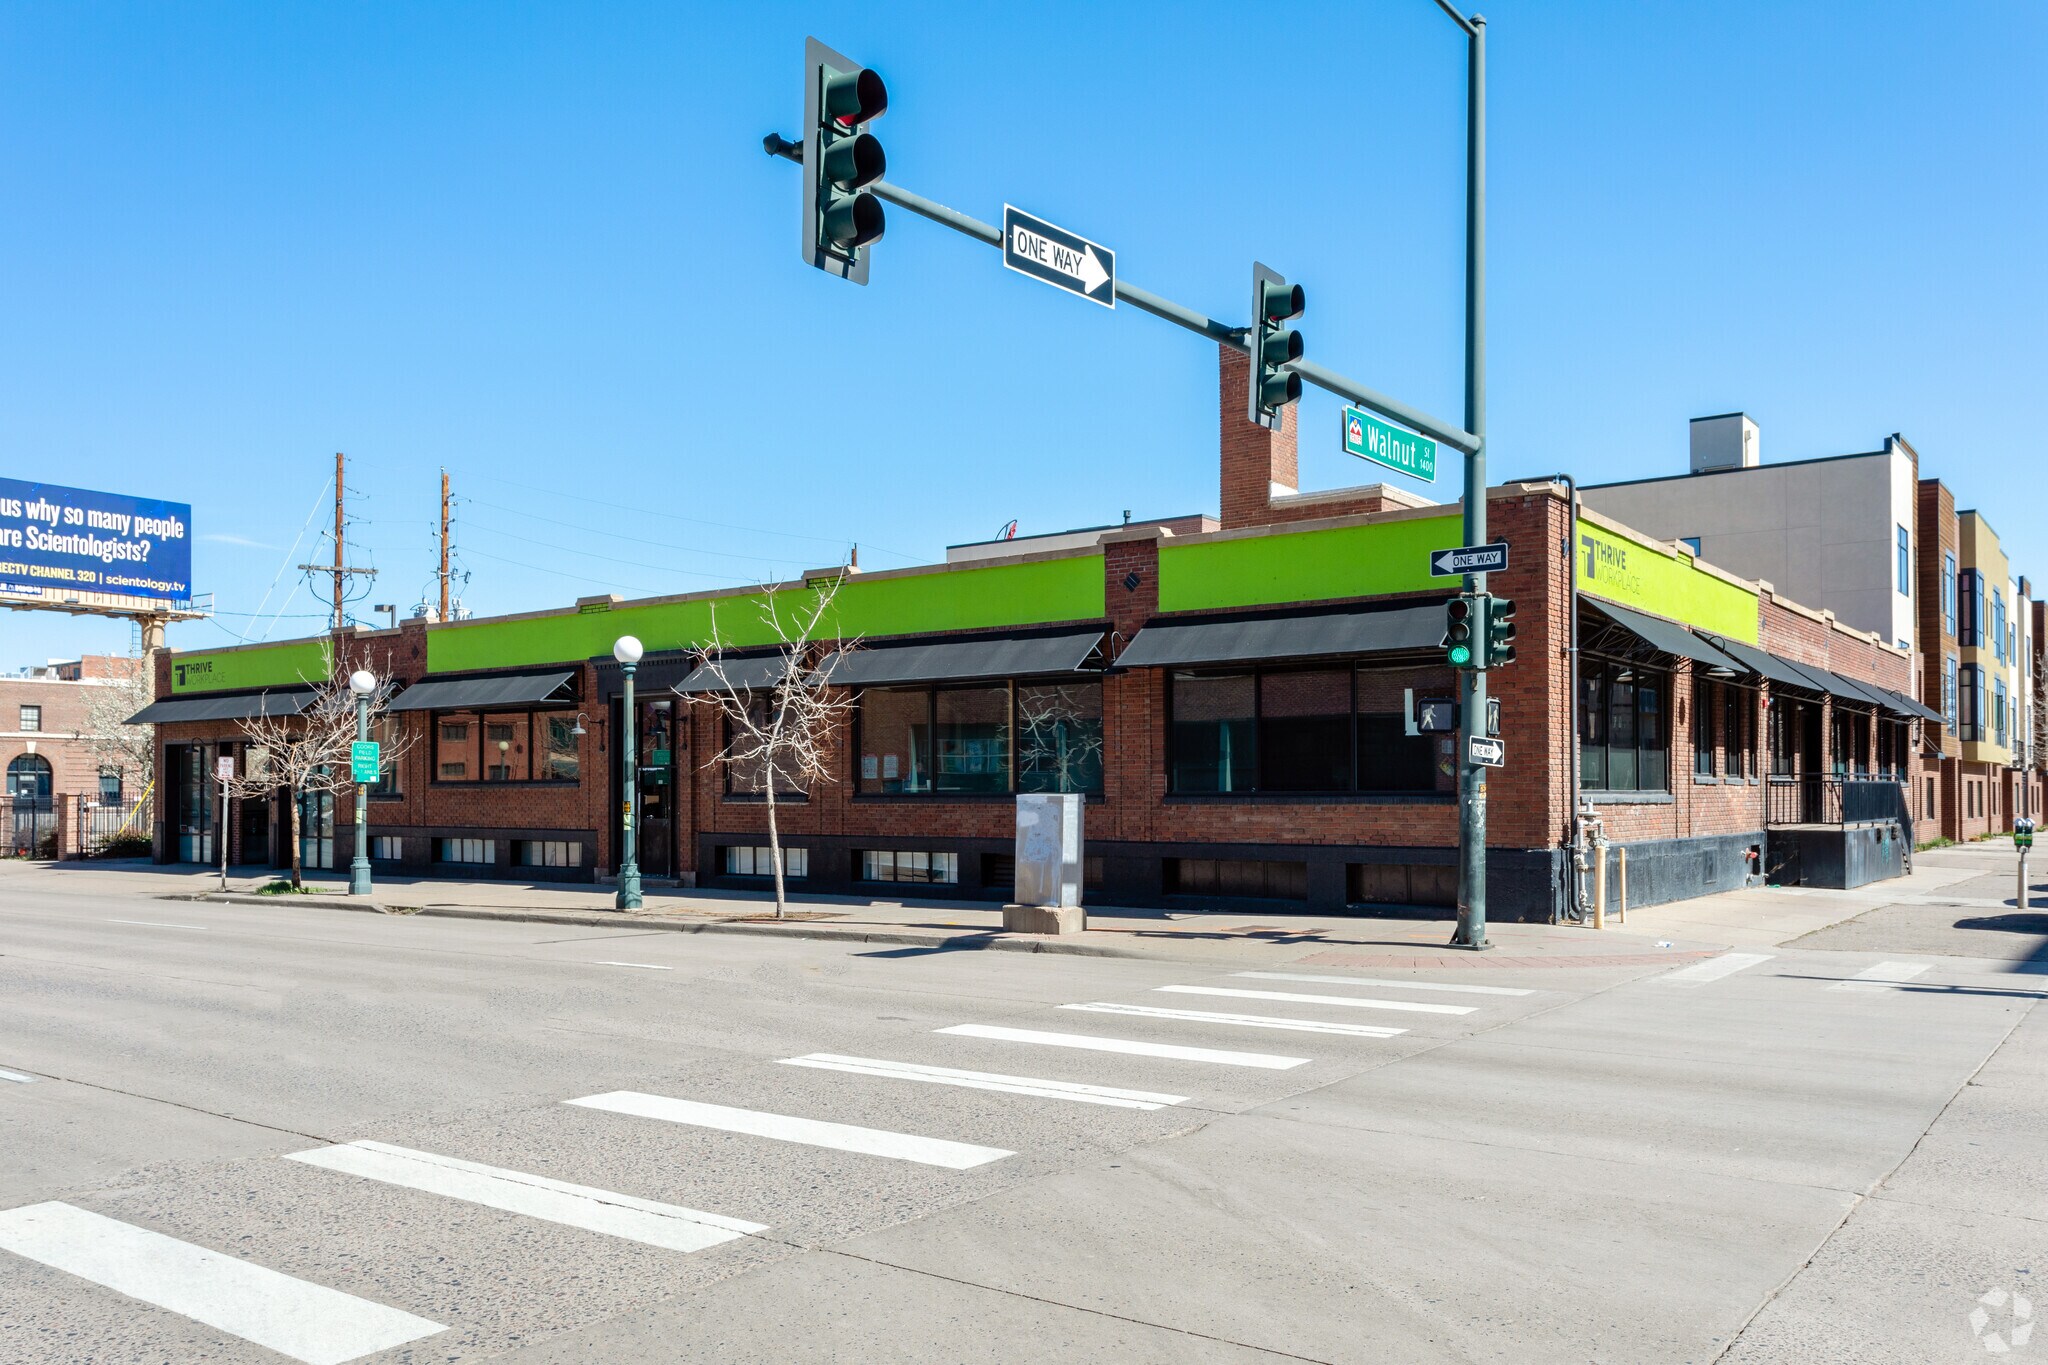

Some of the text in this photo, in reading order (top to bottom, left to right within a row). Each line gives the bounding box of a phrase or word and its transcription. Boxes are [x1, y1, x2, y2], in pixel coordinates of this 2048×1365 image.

[1018, 231, 1083, 276] ONE WAY
[1367, 424, 1416, 468] Walnut
[1424, 447, 1430, 458] St
[1420, 459, 1433, 473] 1400
[25, 498, 60, 527] why
[64, 507, 84, 526] so
[88, 509, 131, 536] many
[134, 516, 184, 541] people
[26, 525, 151, 563] Scientologists?
[1453, 552, 1498, 566] ONE WAY
[1595, 540, 1626, 570] THRIVE
[0, 562, 186, 592] ECTV CHANNEL 320 scientology.tv
[1596, 565, 1640, 595] WORKPLACE
[186, 661, 213, 675] THRIVE
[186, 671, 226, 686] WORKPLACE
[1473, 745, 1493, 757] ONE WAY
